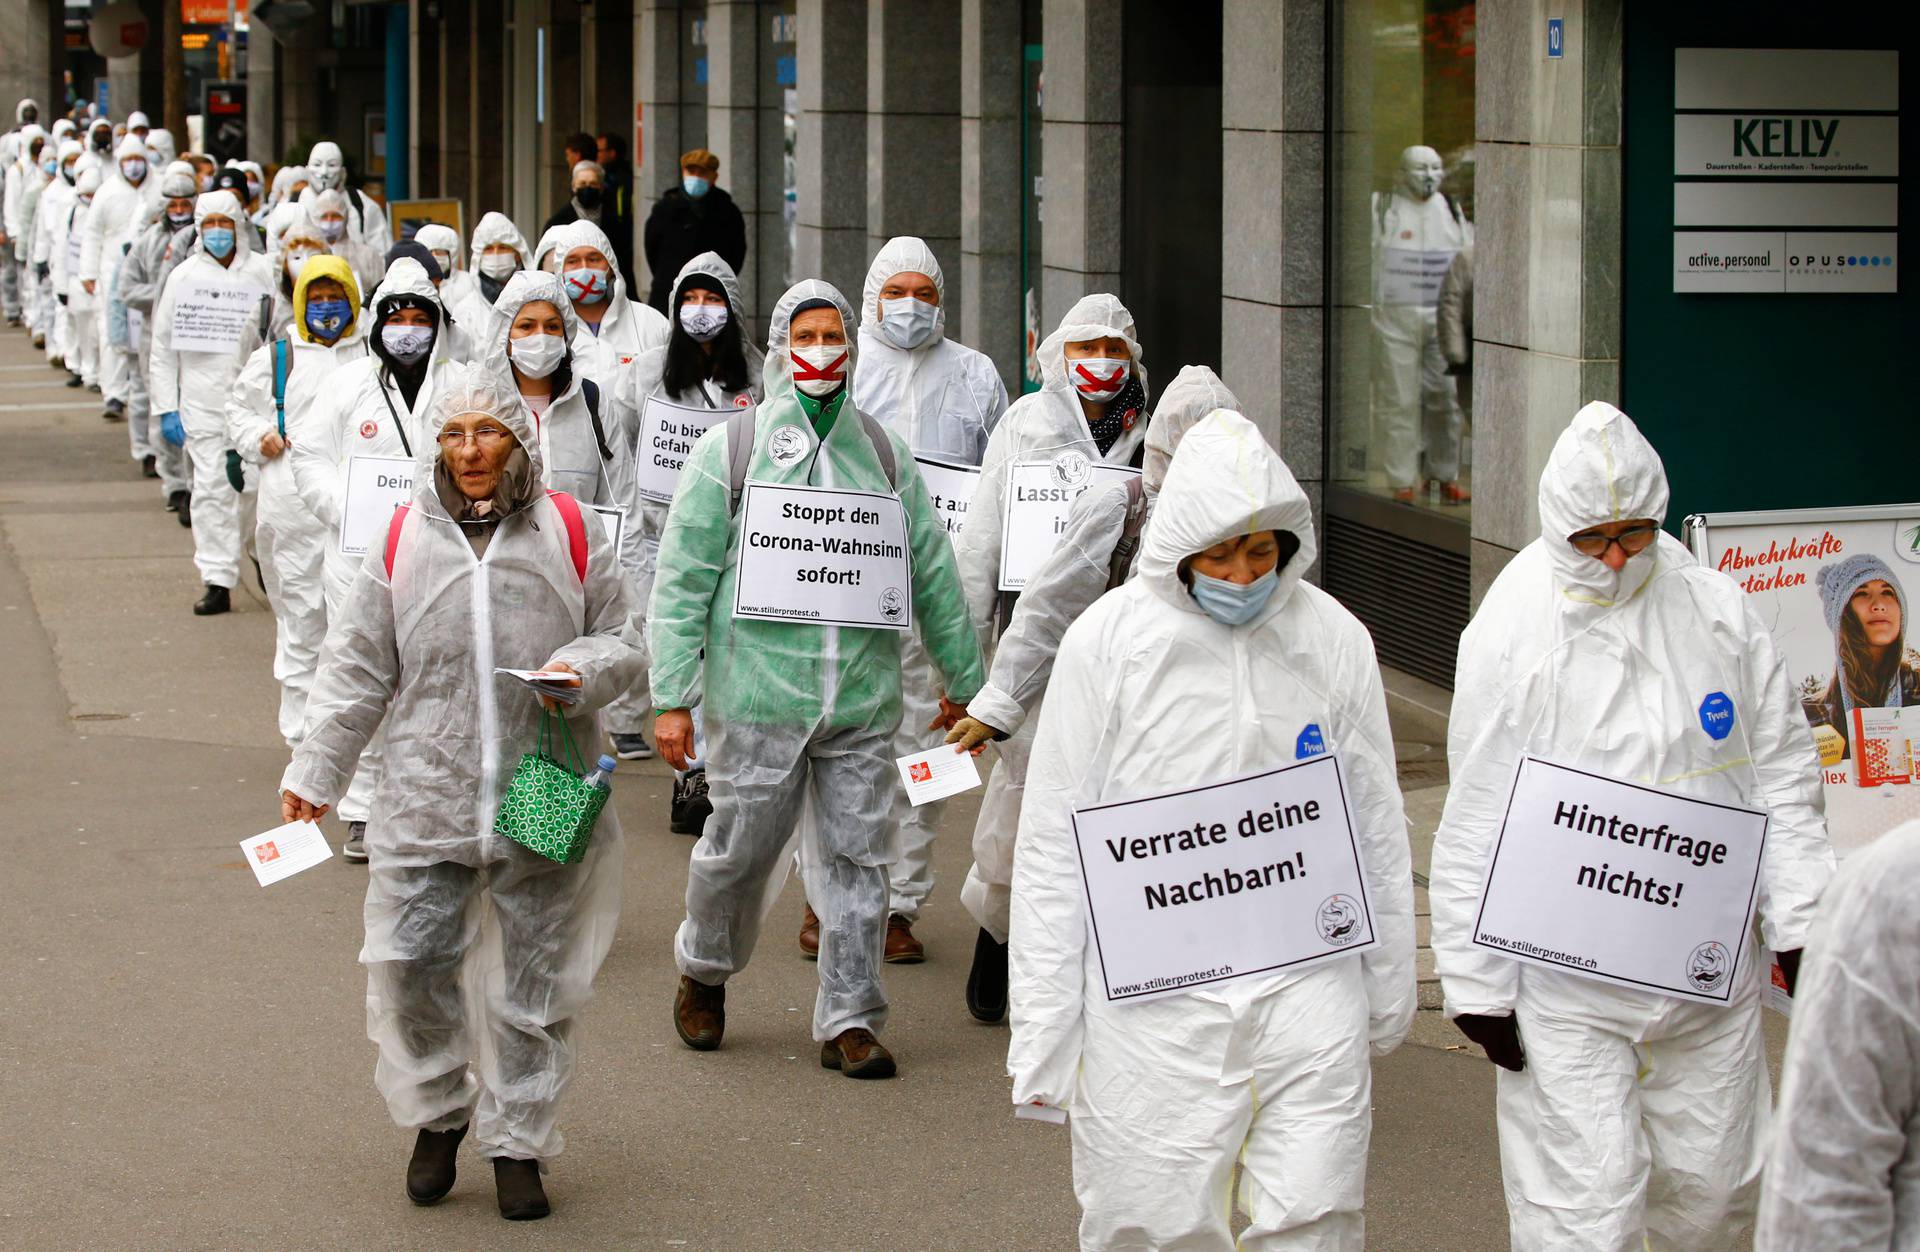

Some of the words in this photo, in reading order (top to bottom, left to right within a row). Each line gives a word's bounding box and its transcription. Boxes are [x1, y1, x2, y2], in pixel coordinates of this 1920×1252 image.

[1551, 26, 1560, 49] 10
[1734, 119, 1839, 157] KELLY
[1706, 163, 1752, 171] Dauerstellen
[1758, 163, 1804, 171] Kaderstellen
[1689, 250, 1770, 269] active.personal
[1789, 256, 1845, 266] OPUS
[661, 419, 677, 435] Du
[653, 436, 694, 455] Gefah
[1017, 486, 1069, 502] Lasst
[782, 502, 846, 526] Stoppt
[850, 507, 880, 525] den
[749, 532, 903, 559] Corona-Wahnsinn
[1717, 531, 1844, 573] Abwehrkräfte
[796, 566, 862, 586] sofort!
[1740, 566, 1807, 594] tärken
[740, 605, 820, 618] www.stillerprotest.ch
[1705, 709, 1729, 723] Tyvek
[1106, 822, 1227, 863] Verrate
[1237, 800, 1321, 838] deine
[1553, 800, 1728, 867] Hinterfrage
[1144, 851, 1307, 910] Nachbarn!
[1576, 863, 1684, 908] nichts!
[1480, 932, 1598, 969] www.stillerprotest.ch
[1112, 965, 1233, 996] www.stillerprotest.ch
